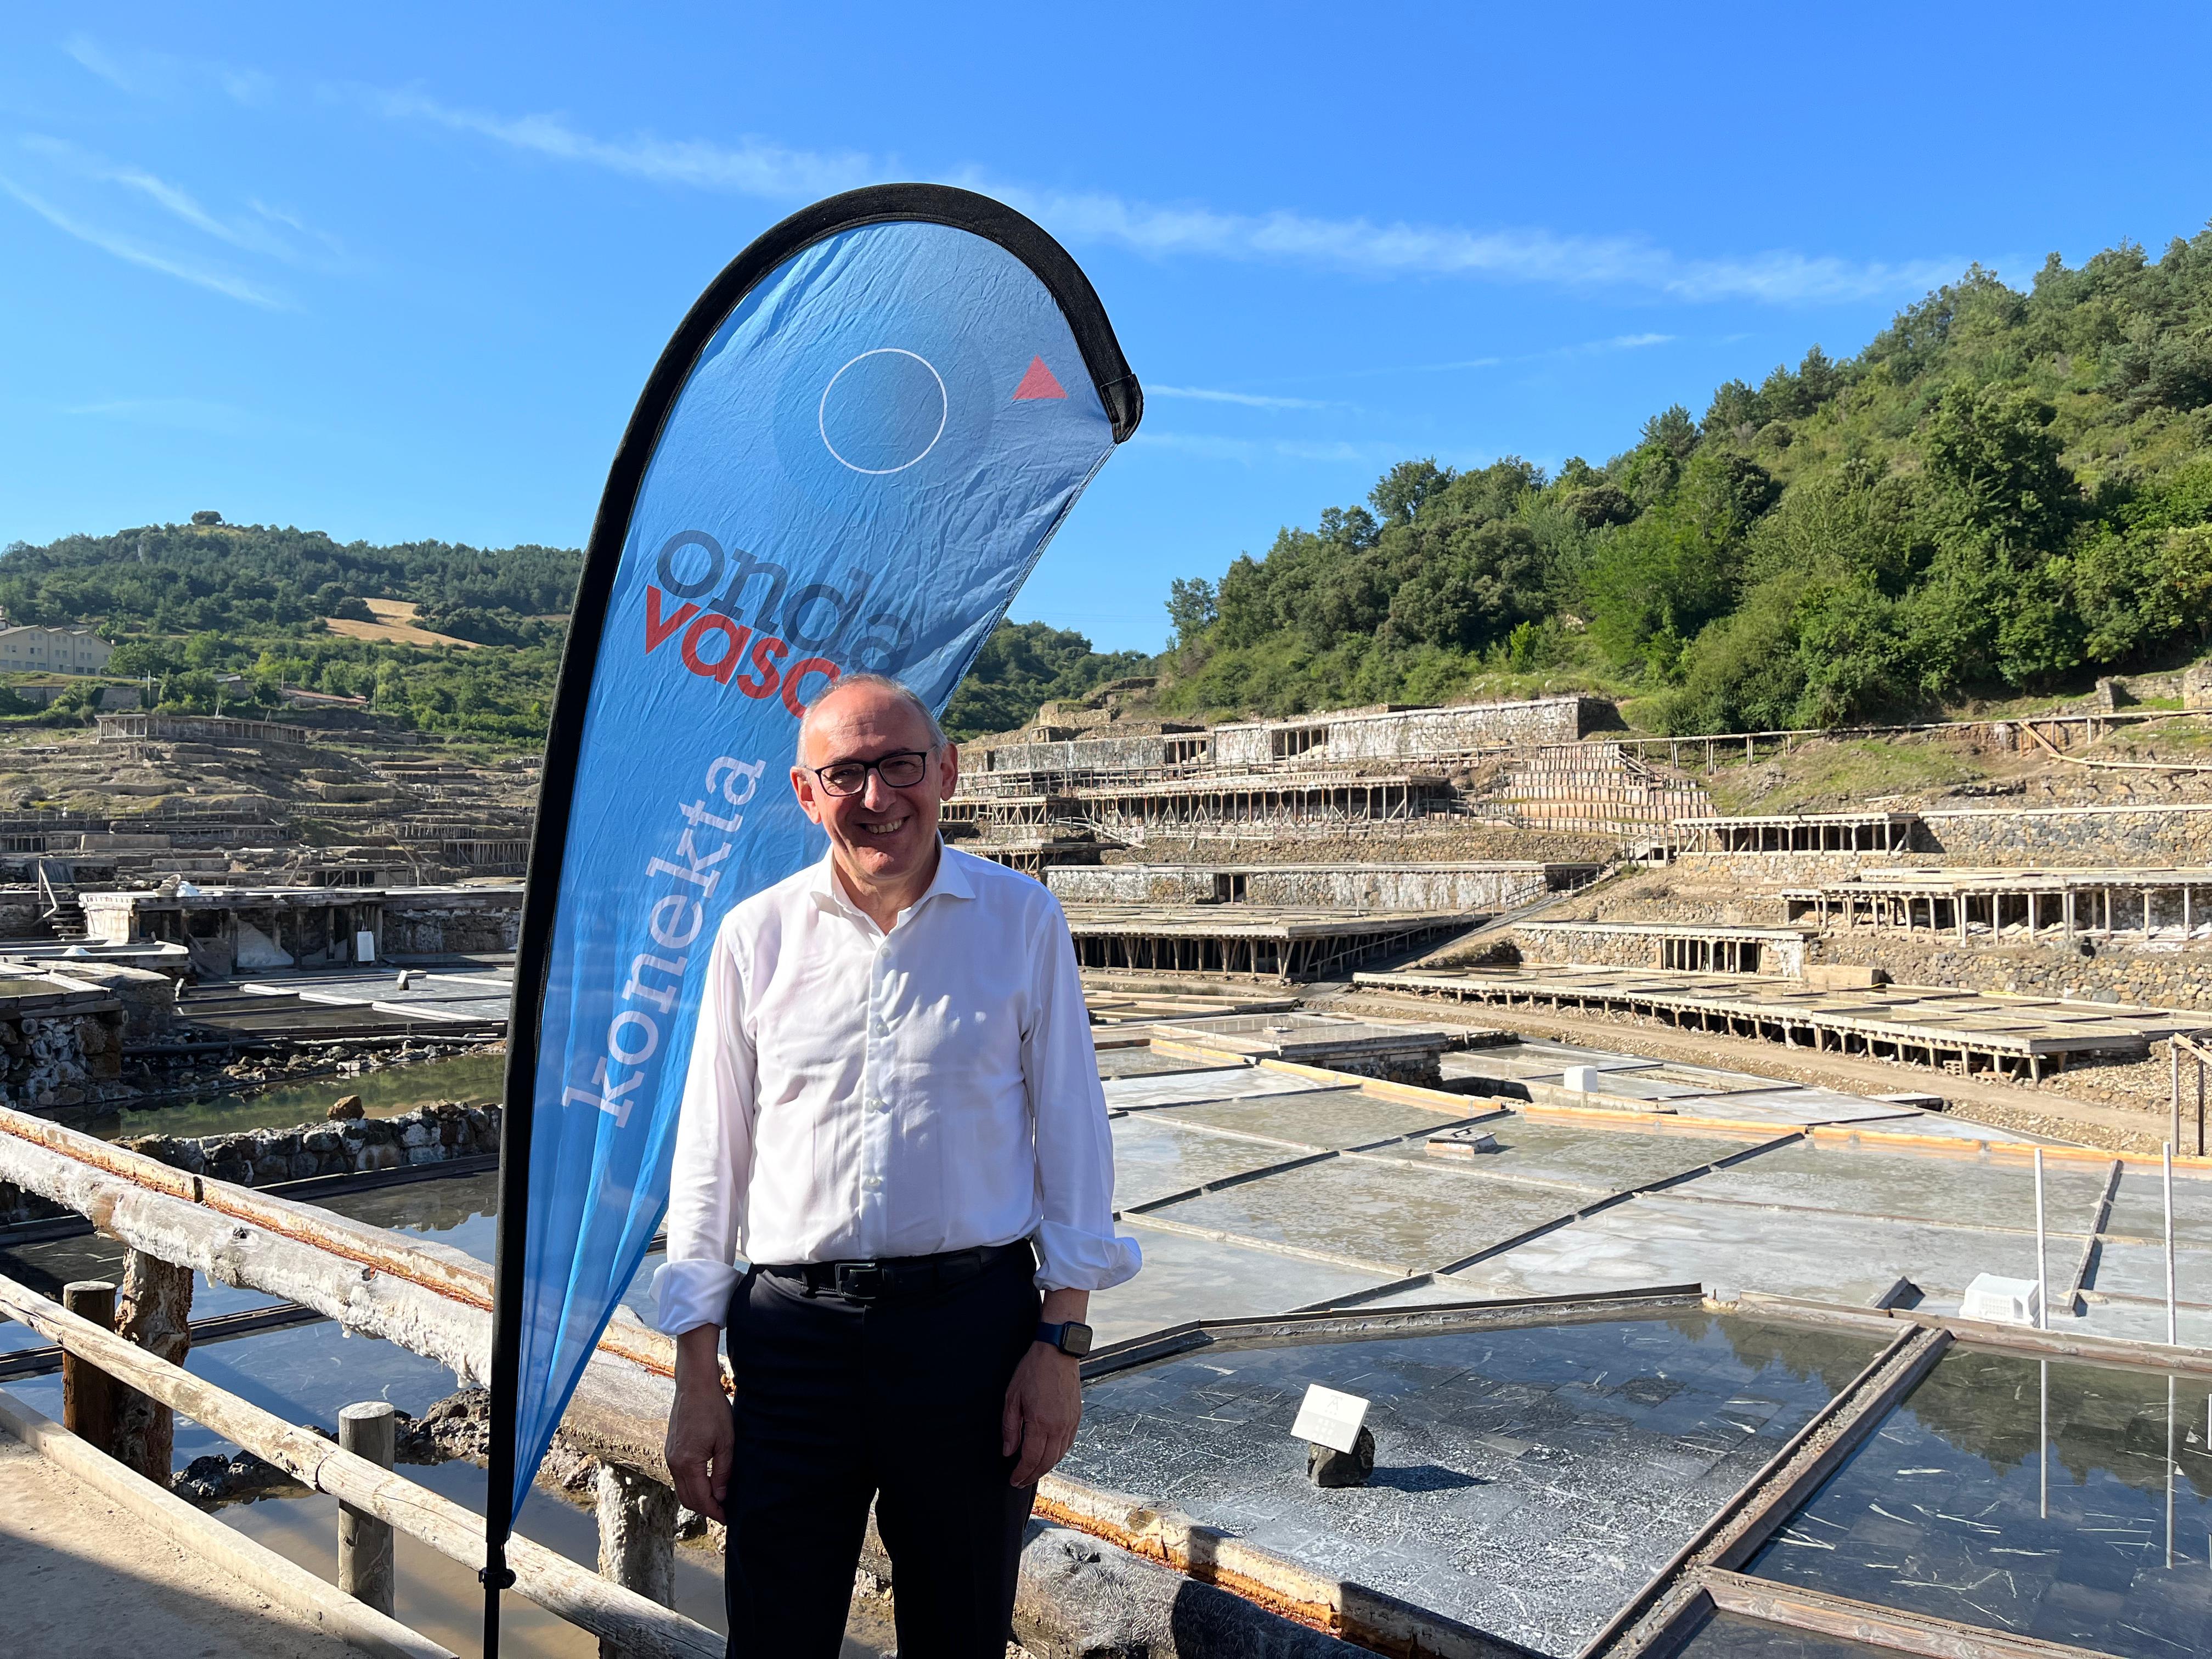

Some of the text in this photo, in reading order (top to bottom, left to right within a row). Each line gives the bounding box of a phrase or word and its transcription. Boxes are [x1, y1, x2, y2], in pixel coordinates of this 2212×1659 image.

[645, 584, 842, 719] vasc
[657, 530, 914, 677] onda
[560, 756, 766, 1128] konekta
